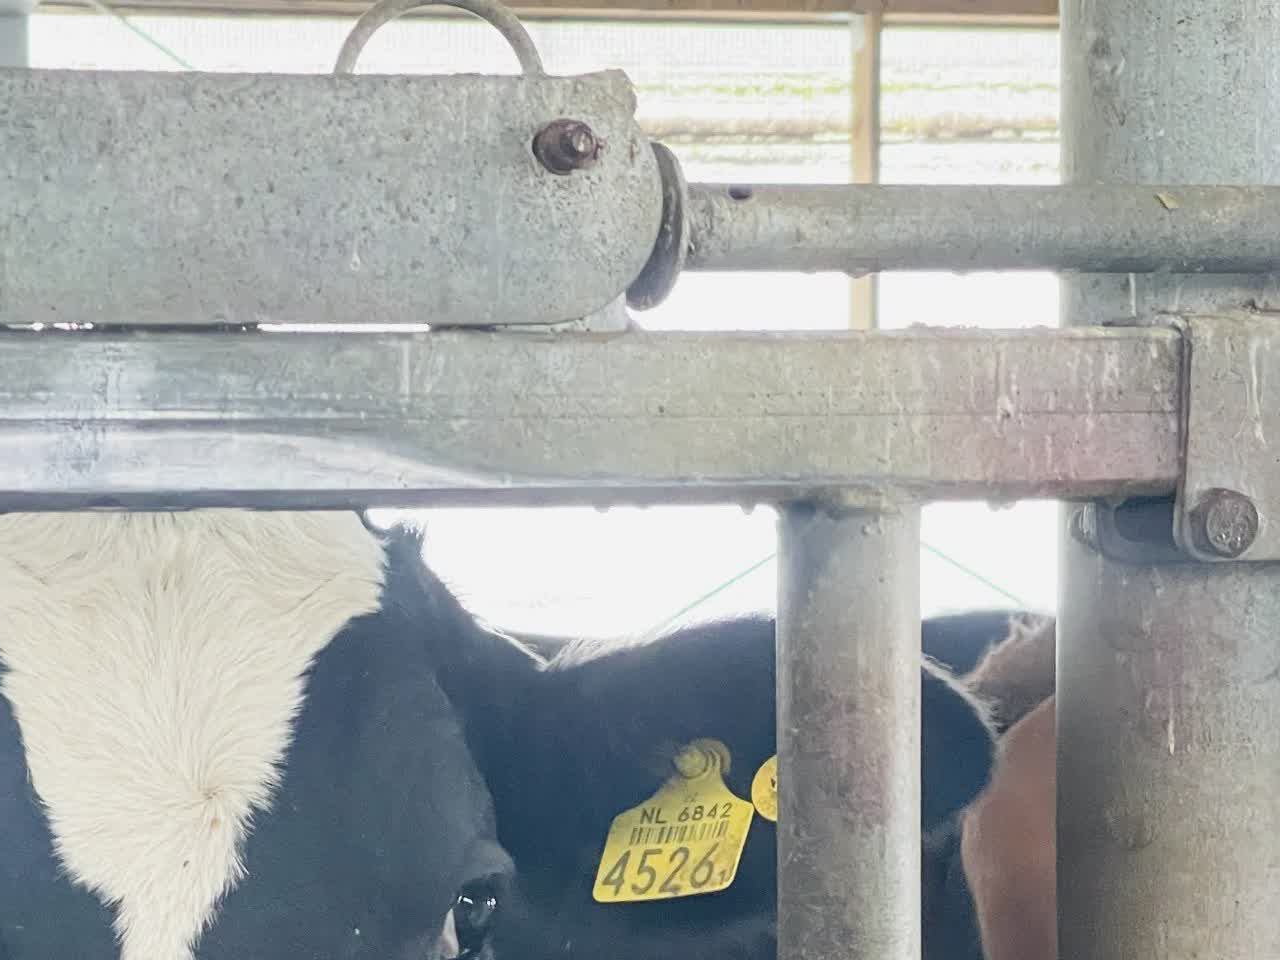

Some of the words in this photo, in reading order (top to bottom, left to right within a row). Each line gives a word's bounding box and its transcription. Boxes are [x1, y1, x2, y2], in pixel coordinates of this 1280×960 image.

[640, 807, 667, 824] NL
[677, 802, 732, 822] 6842
[601, 842, 720, 897] 4526
